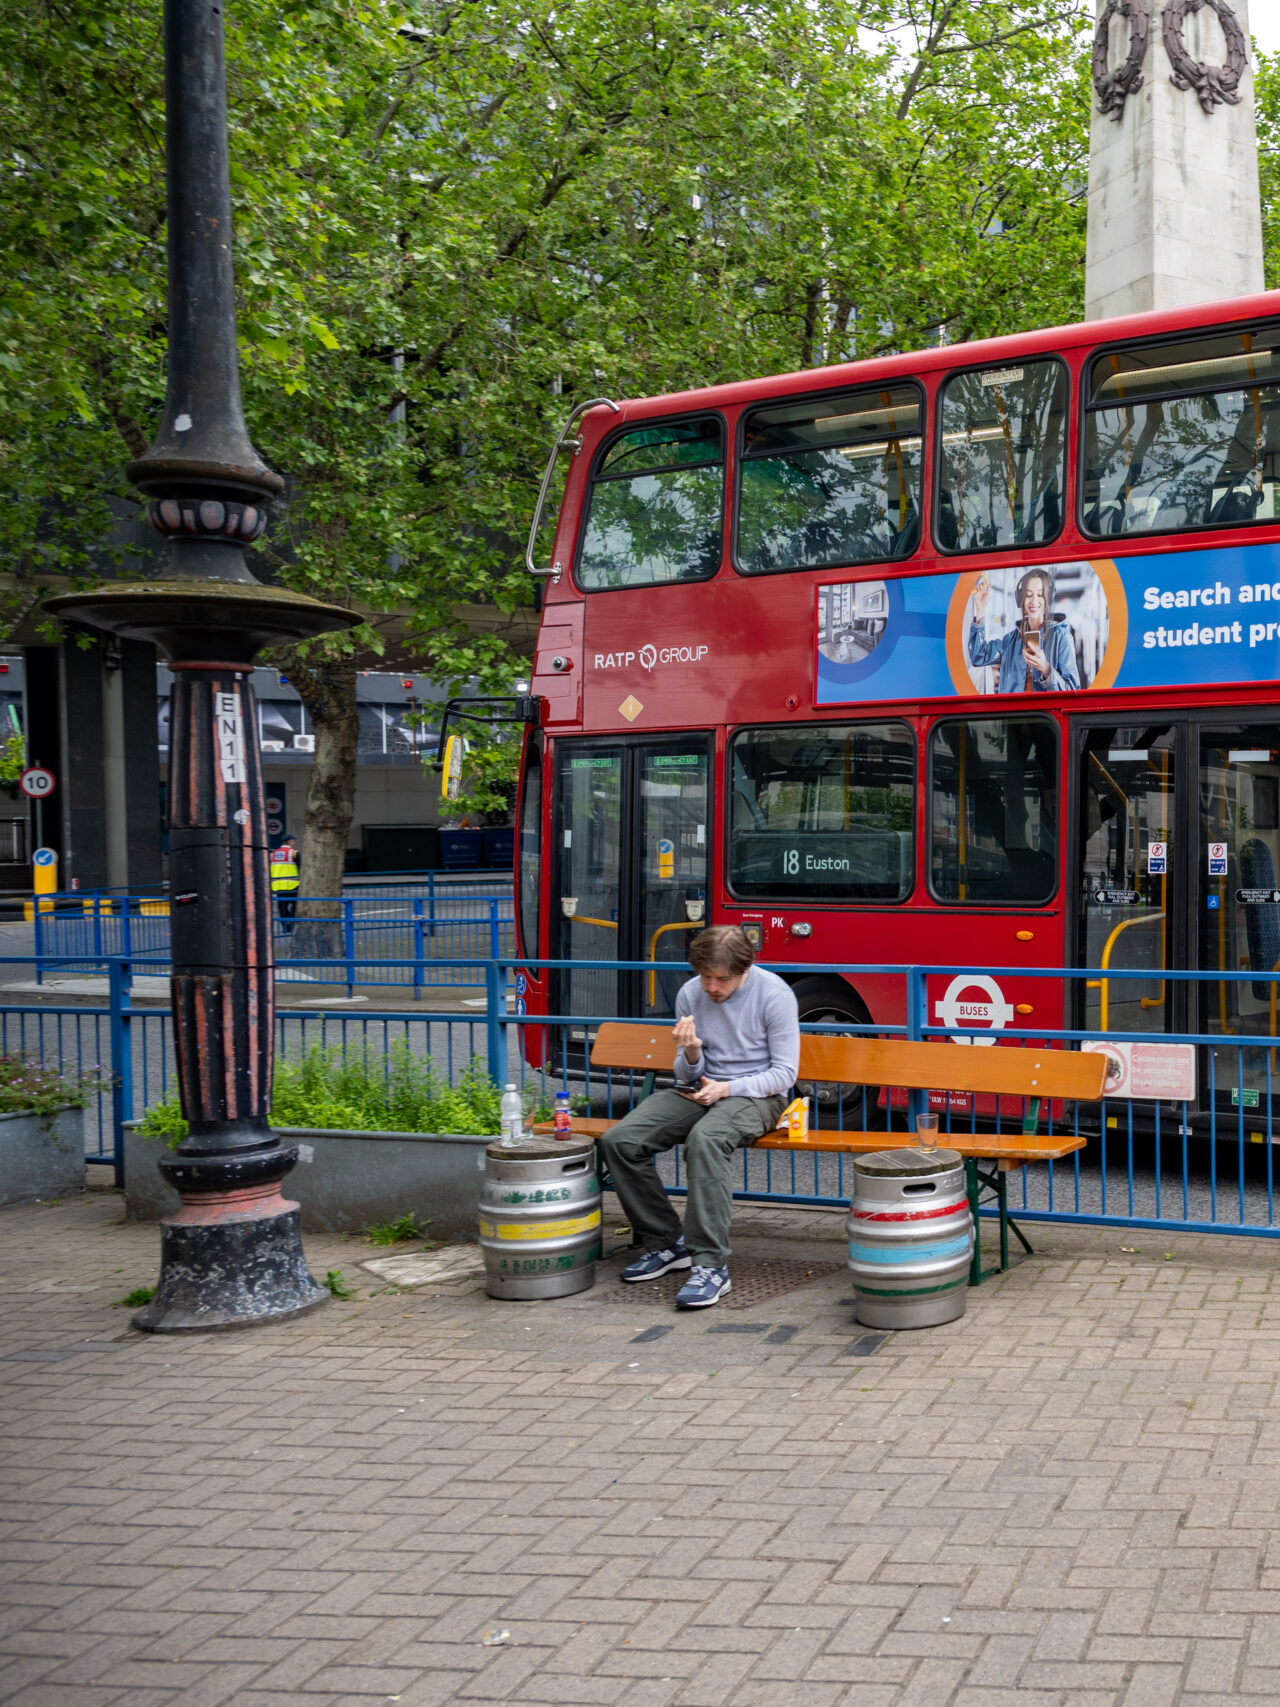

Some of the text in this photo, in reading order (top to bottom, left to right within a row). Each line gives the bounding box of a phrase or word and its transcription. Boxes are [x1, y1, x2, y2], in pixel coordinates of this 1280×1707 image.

[1143, 581, 1231, 610] Search
[1143, 621, 1242, 649] student
[594, 645, 709, 669] RATP GROUP
[26, 777, 48, 789] 10
[783, 849, 850, 875] 18 Euston
[771, 917, 784, 928] PK
[960, 1005, 989, 1016] BUSES
[1132, 1055, 1155, 1065] Cycles
